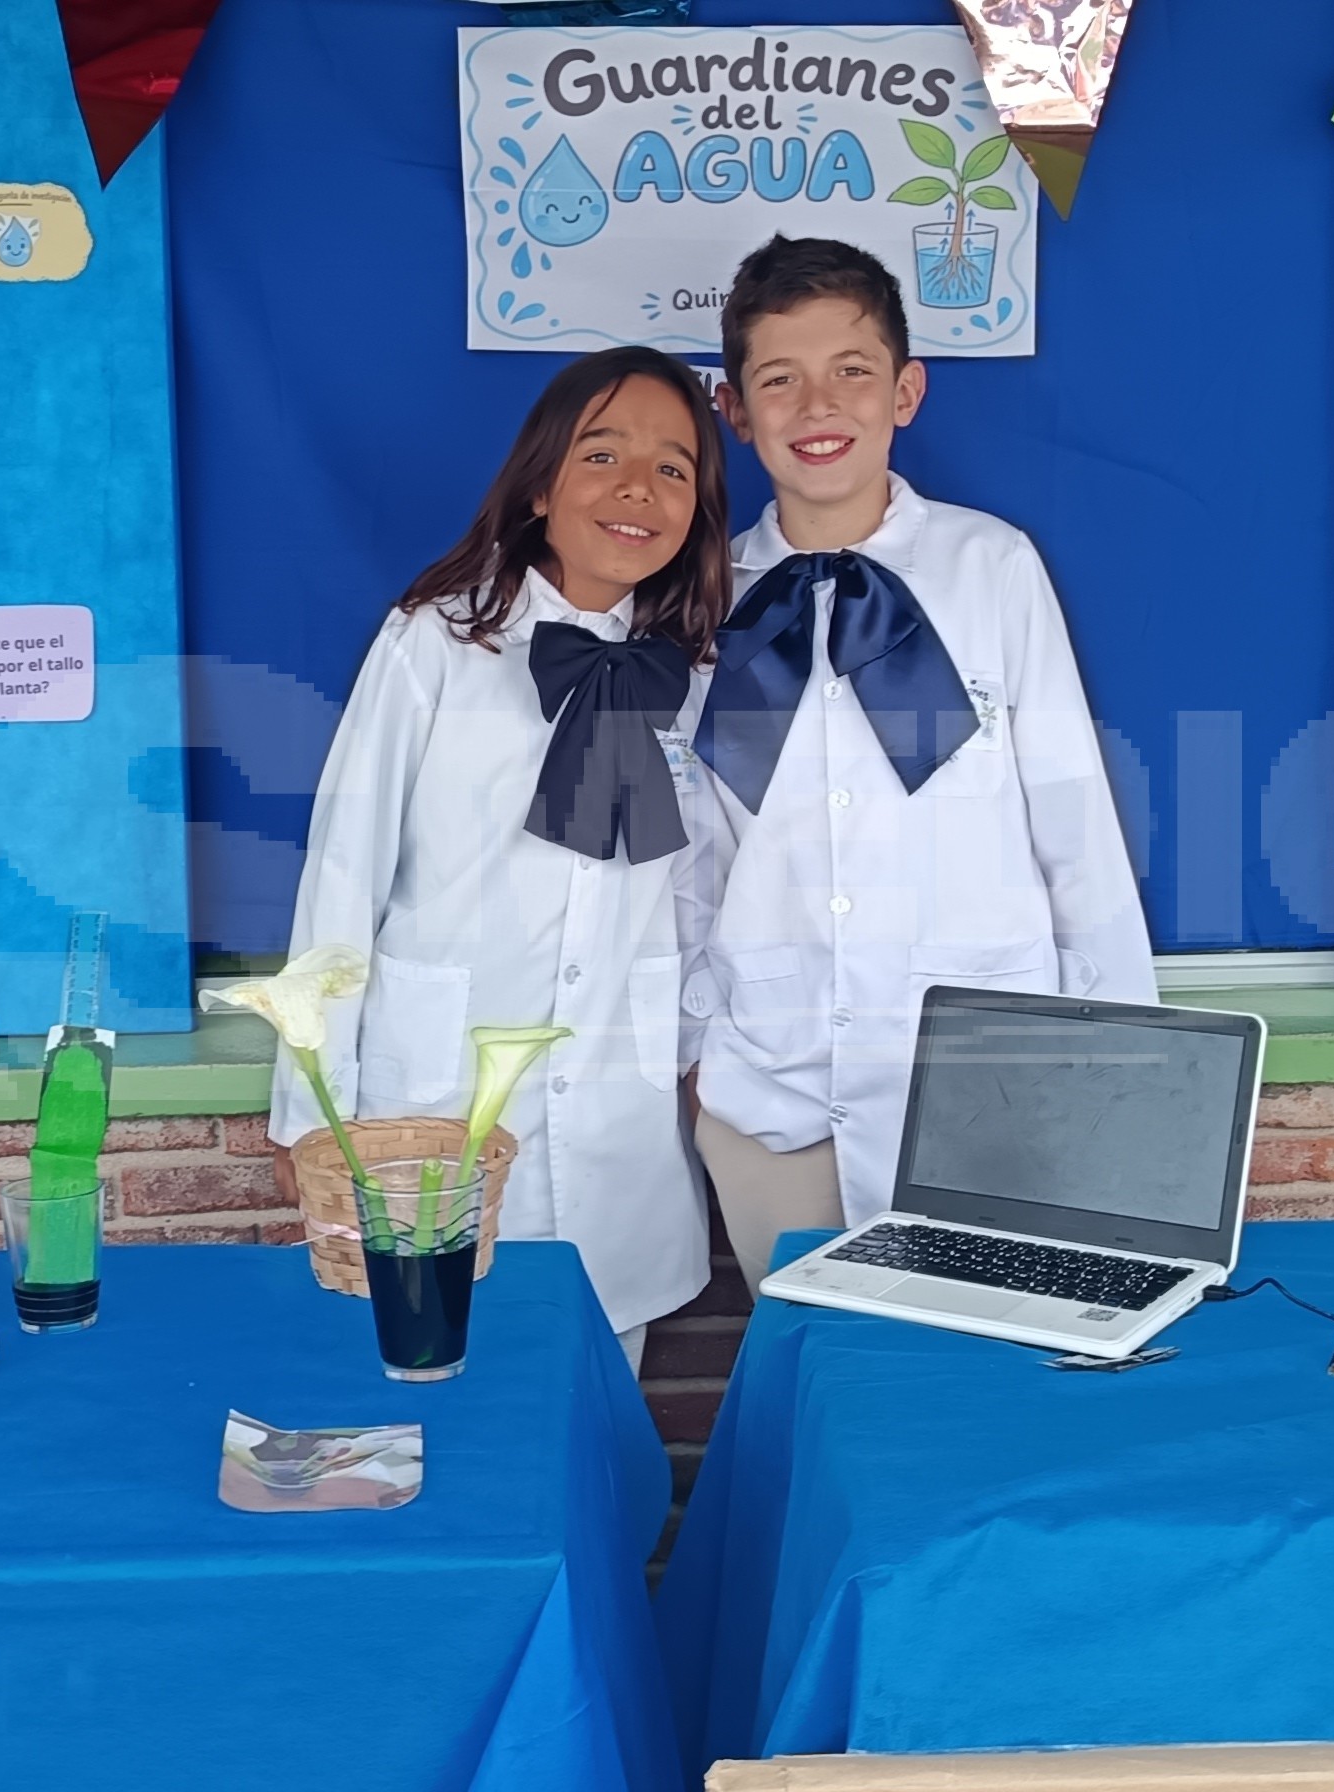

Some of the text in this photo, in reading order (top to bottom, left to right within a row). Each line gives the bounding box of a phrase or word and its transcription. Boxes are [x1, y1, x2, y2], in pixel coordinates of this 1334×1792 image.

[543, 36, 955, 117] Guardianes
[701, 94, 782, 131] del
[613, 129, 876, 204] AGUA
[14, 638, 45, 652] que
[49, 635, 64, 648] el
[28, 658, 42, 671] el
[47, 657, 83, 671] tallo
